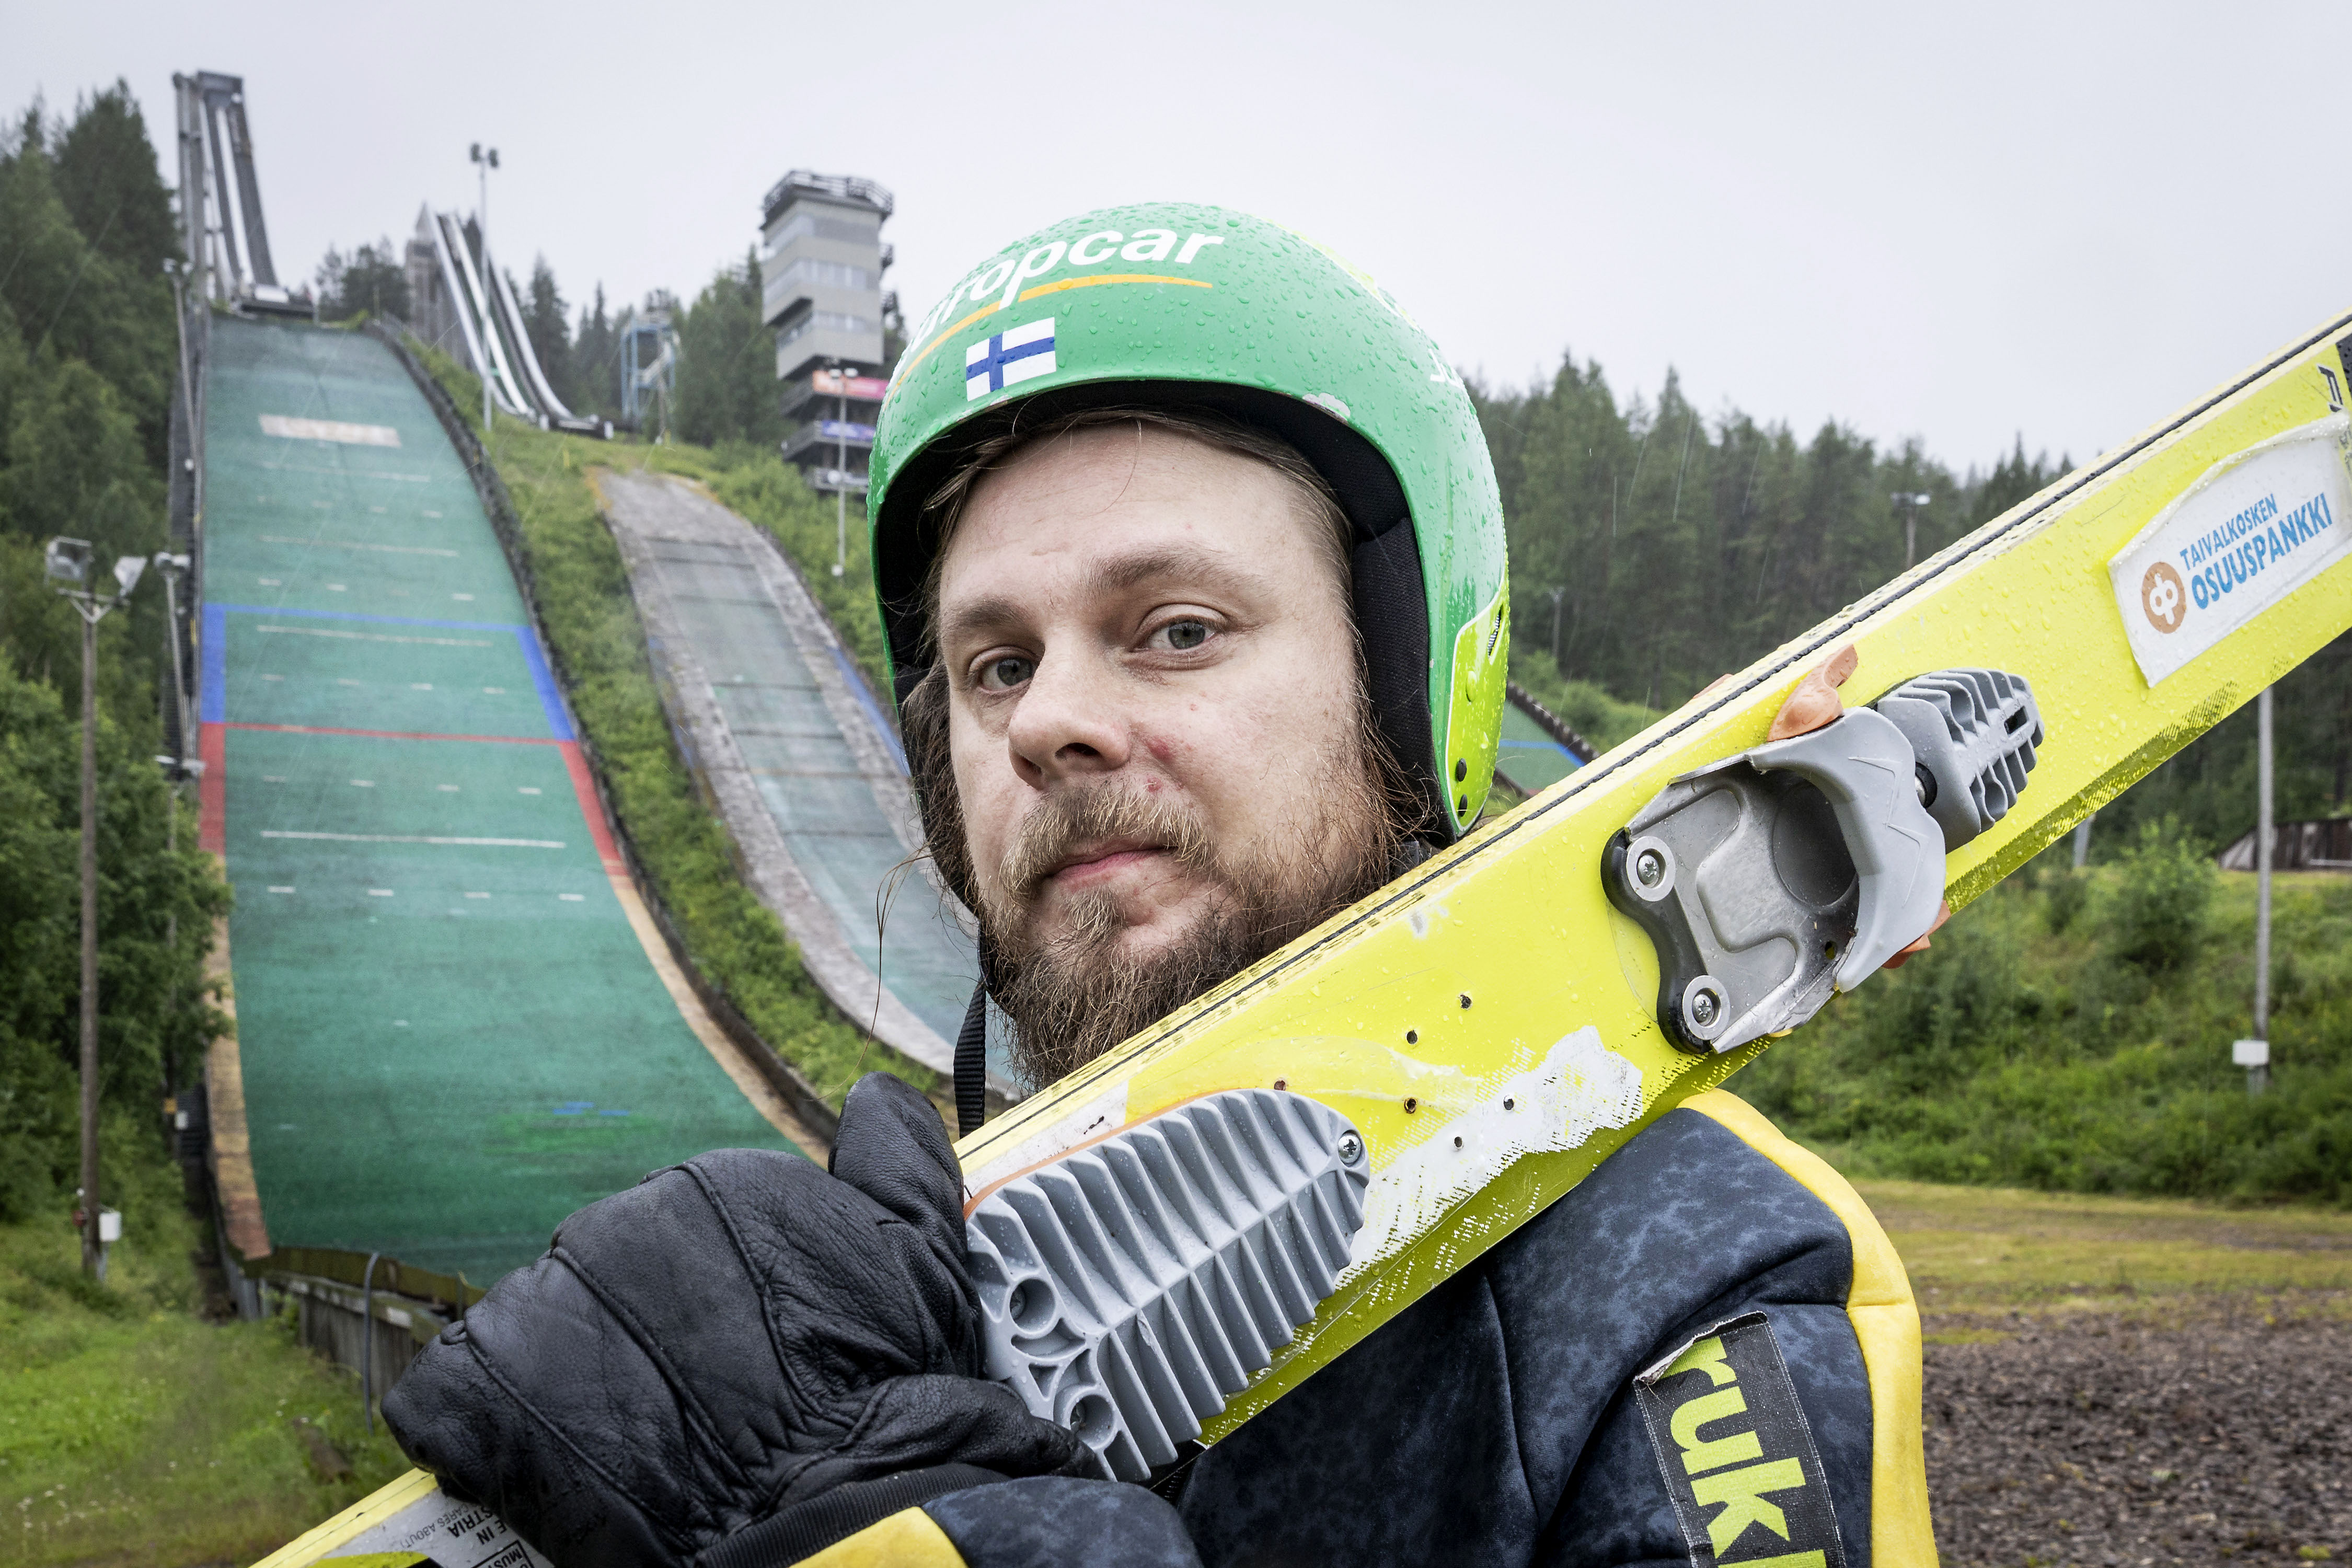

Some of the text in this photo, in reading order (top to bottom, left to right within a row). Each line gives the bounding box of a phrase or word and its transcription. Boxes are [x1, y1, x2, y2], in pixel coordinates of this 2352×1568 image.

[2179, 493, 2278, 571] TAIVALKOSKEN
[2191, 492, 2333, 610] OSUUSPANKKI
[439, 1503, 469, 1527] CARES
[447, 1505, 493, 1538] STRIA
[476, 1526, 495, 1546] IN
